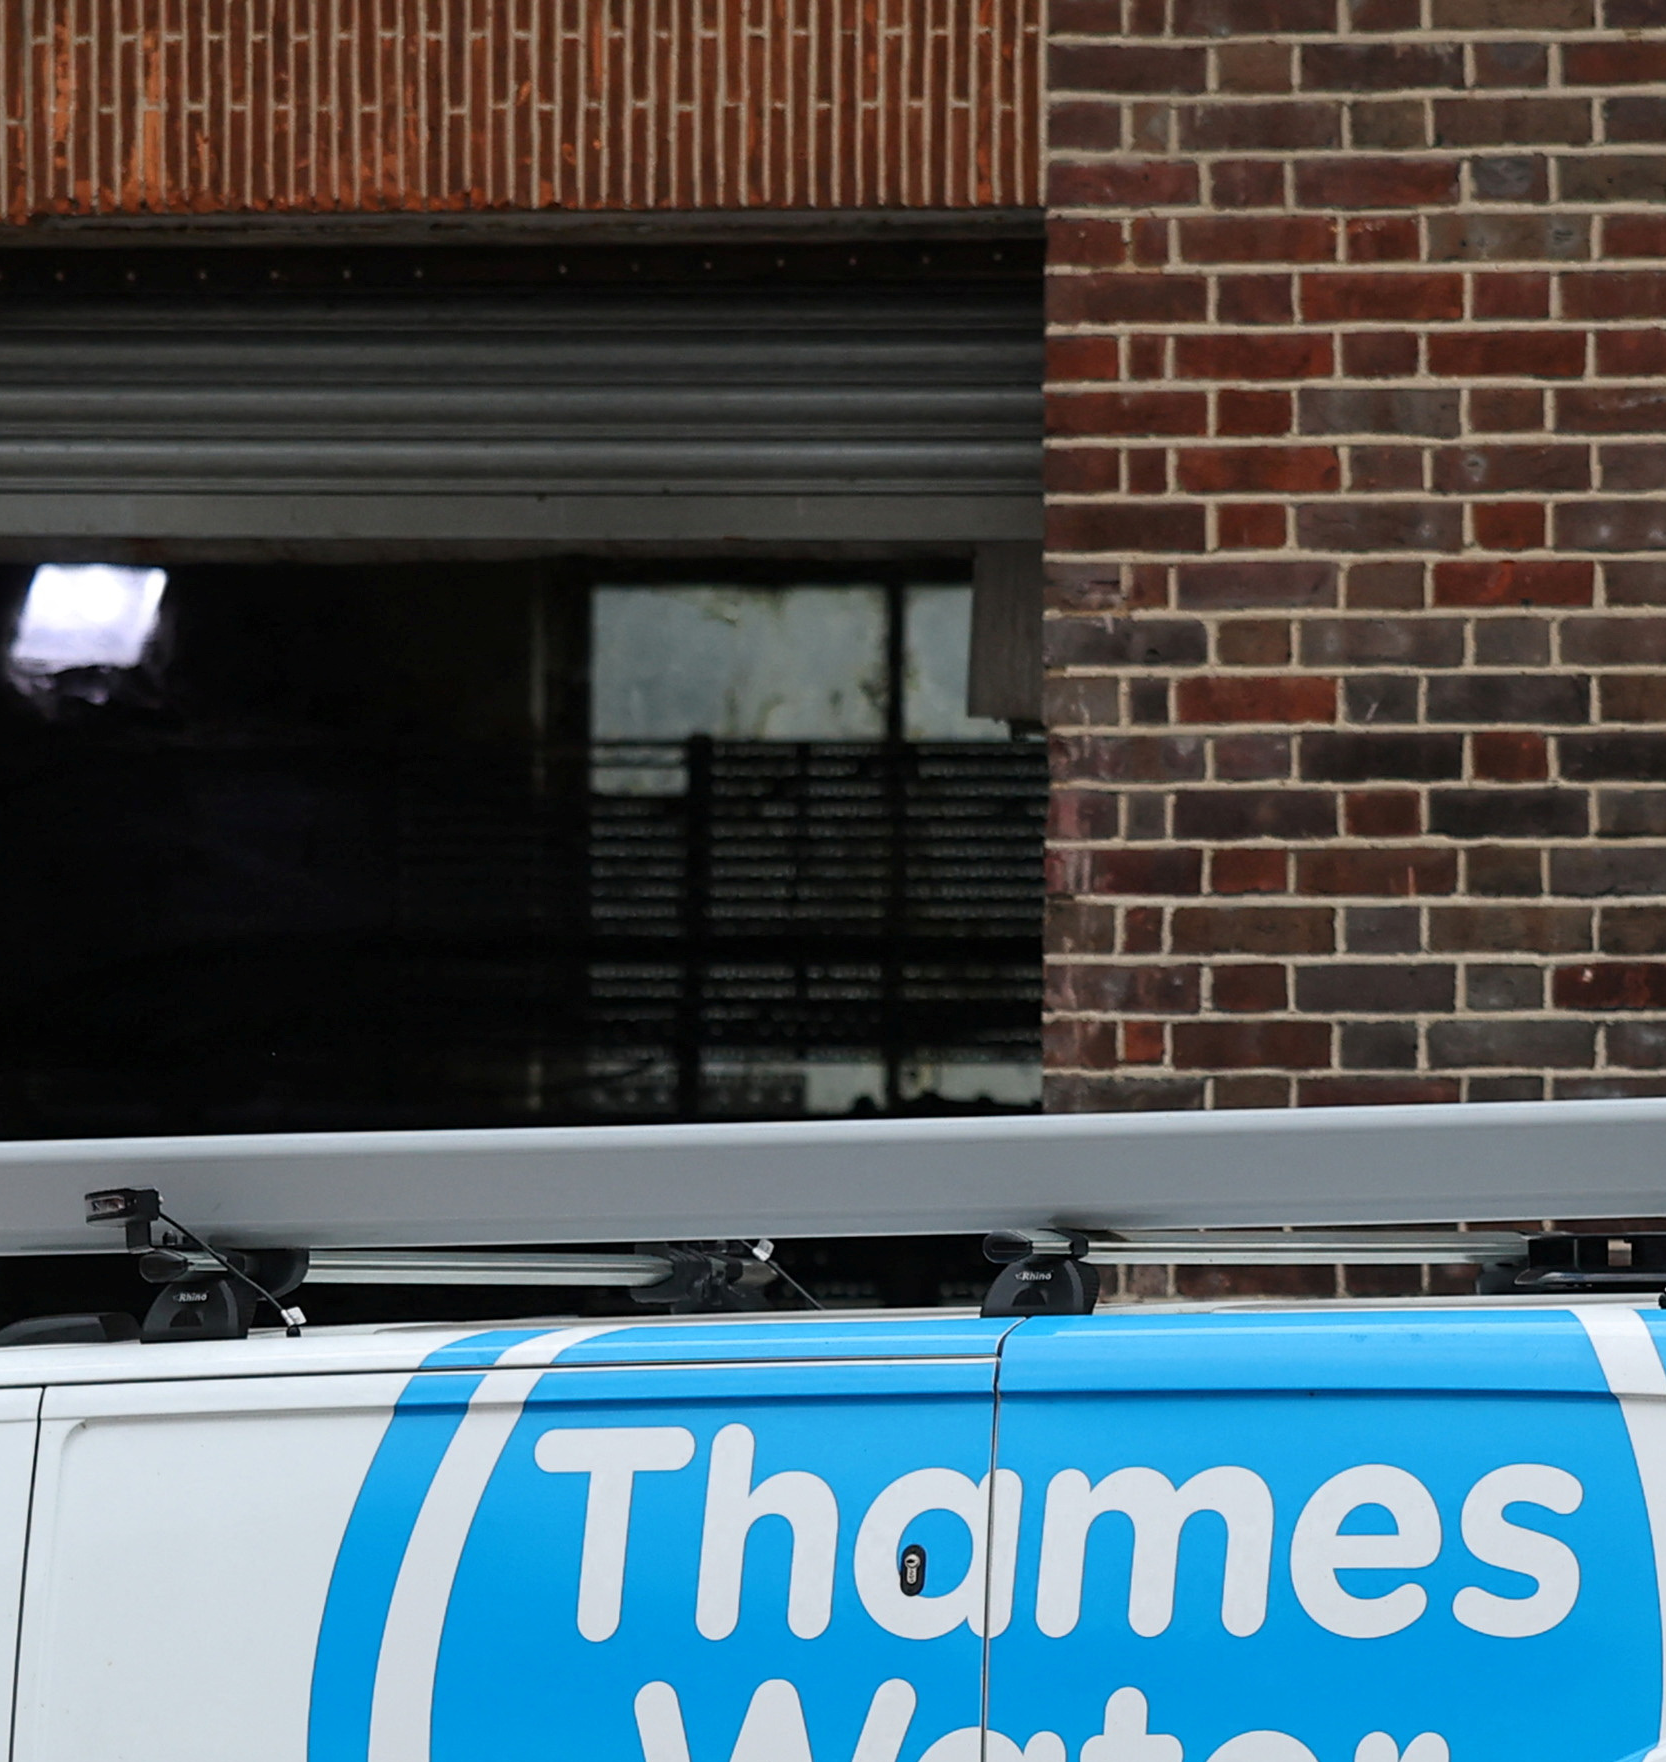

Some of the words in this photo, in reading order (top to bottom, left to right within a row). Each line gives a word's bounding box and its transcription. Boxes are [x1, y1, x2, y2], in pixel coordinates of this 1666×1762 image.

[1021, 1270, 1052, 1281] Rhino
[178, 1292, 208, 1303] Rhino
[534, 1422, 1584, 1642] Thames
